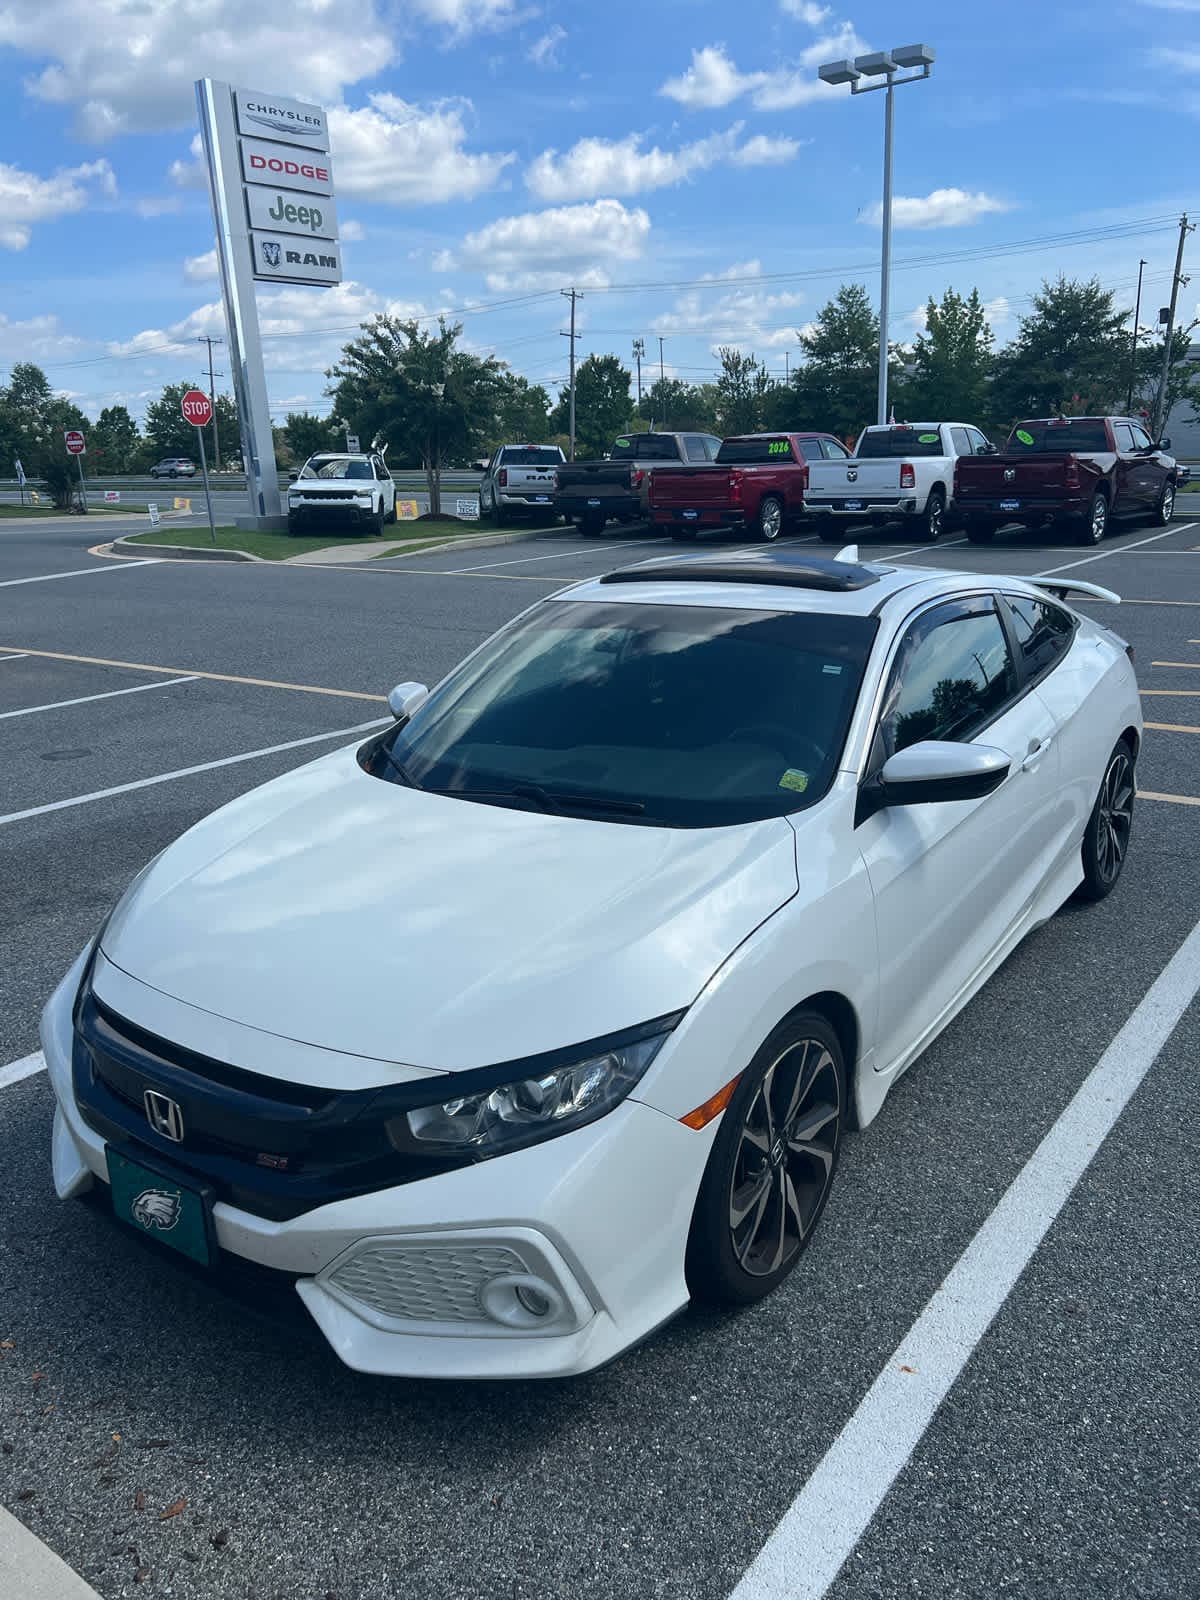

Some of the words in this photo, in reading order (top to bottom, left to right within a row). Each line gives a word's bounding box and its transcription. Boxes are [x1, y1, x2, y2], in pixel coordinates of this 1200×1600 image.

[246, 103, 321, 127] CHRYSLER
[250, 154, 329, 181] DODGE
[269, 195, 323, 231] Jeep
[285, 250, 337, 269] RAM
[184, 401, 210, 415] STOP
[768, 441, 790, 454] 2026
